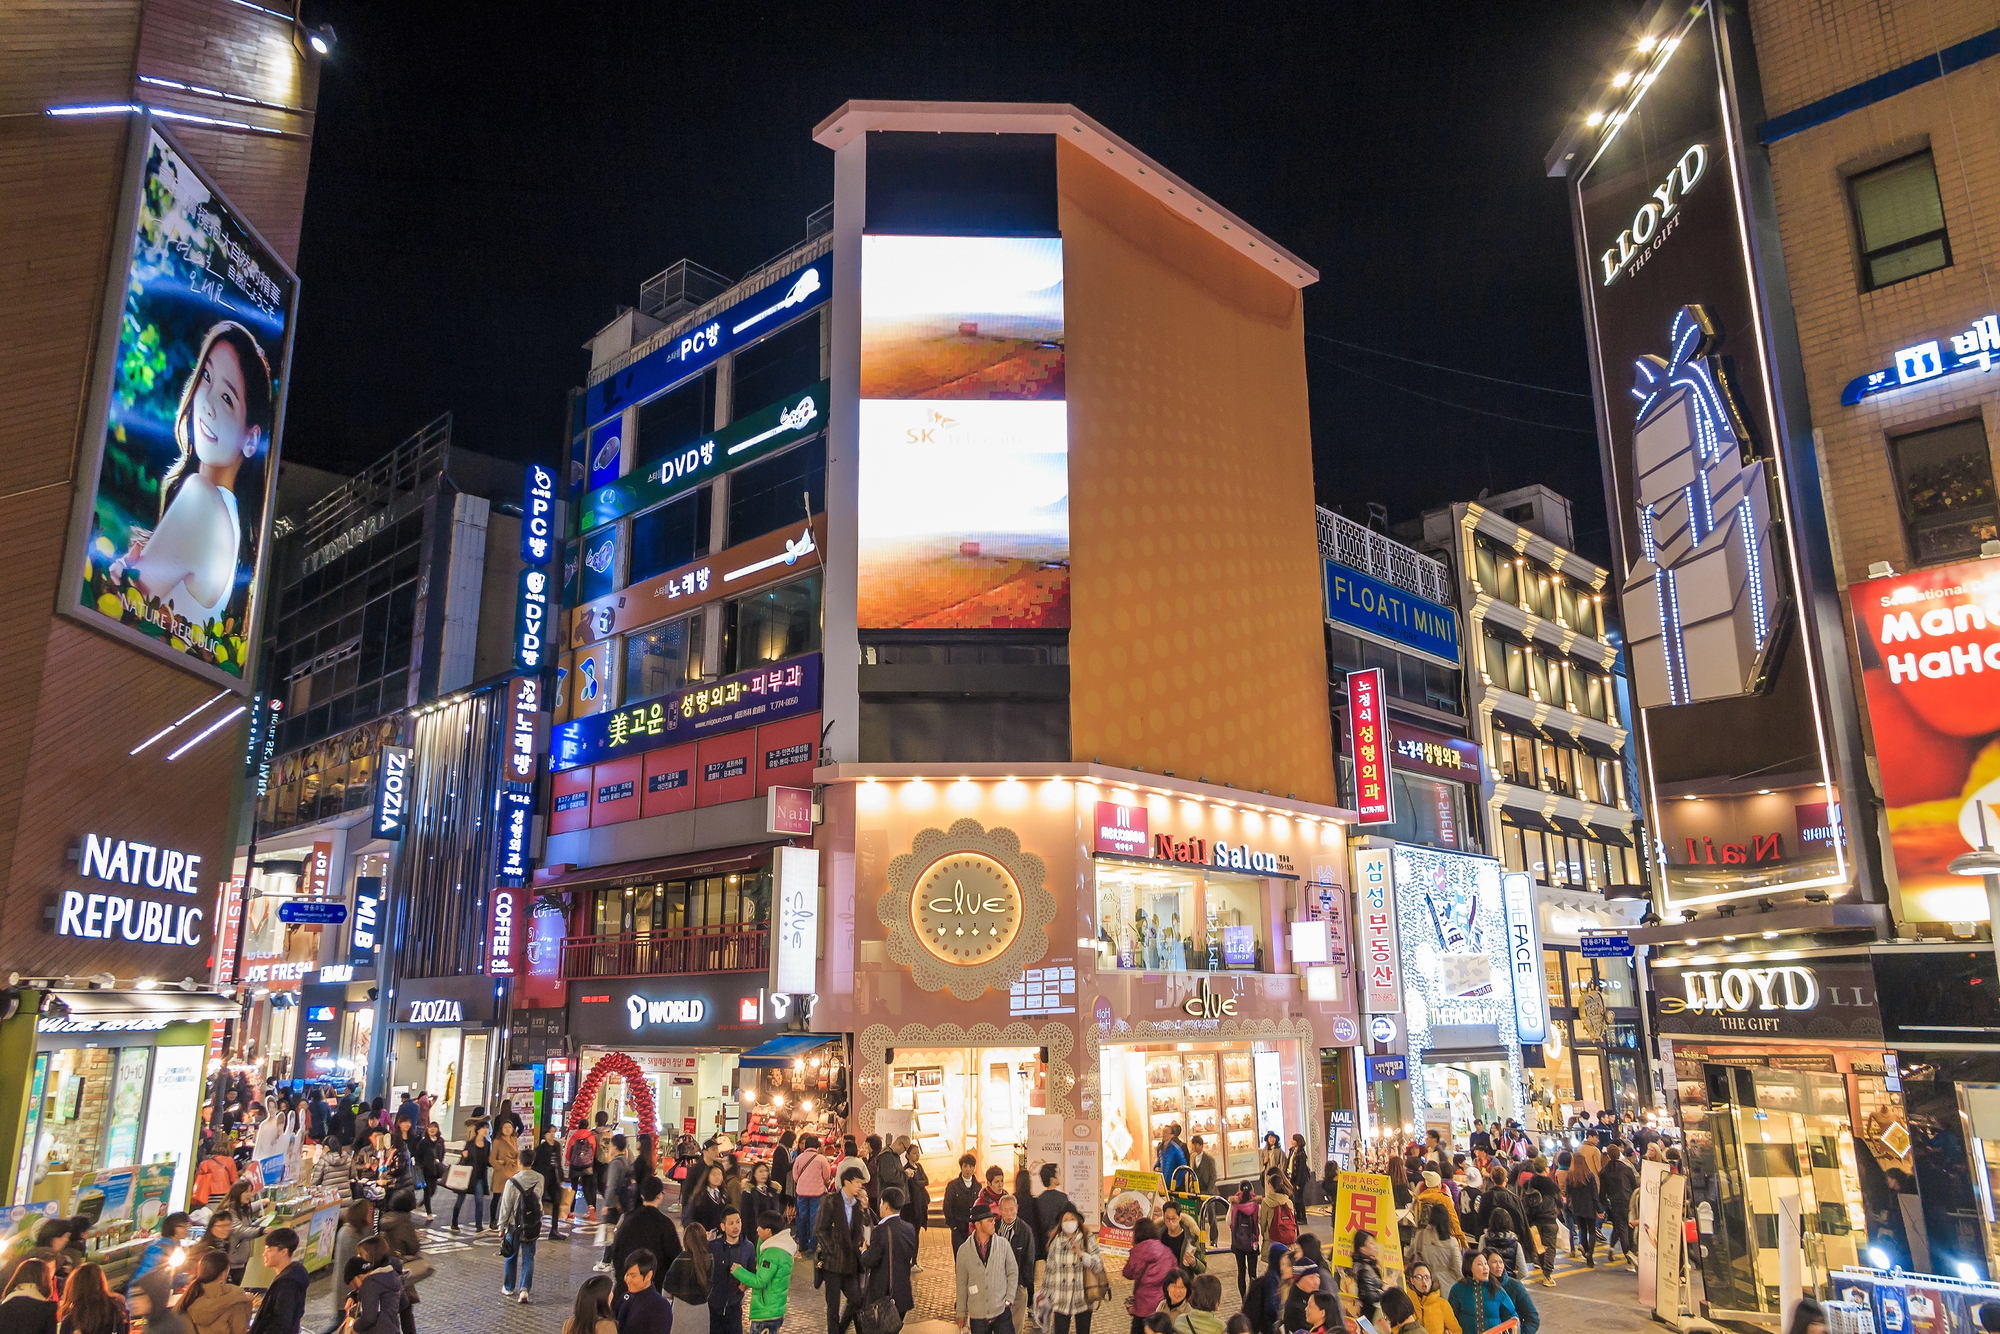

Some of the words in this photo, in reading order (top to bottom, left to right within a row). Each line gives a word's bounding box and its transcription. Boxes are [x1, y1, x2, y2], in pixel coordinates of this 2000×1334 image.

[1601, 144, 1709, 286] LLOYD
[1628, 247, 1651, 278] THE
[1653, 212, 1680, 250] GIFT
[681, 322, 720, 361] PC방
[1868, 371, 1886, 386] 3F
[906, 428, 936, 444] SK
[661, 440, 714, 484] DVD방
[668, 567, 711, 599] 노래방
[119, 590, 167, 630] NATURE
[170, 618, 220, 656] REPUBLIC
[1377, 620, 1395, 635] NEW
[1397, 626, 1418, 643] YORK
[1414, 607, 1452, 643] MINI
[1358, 725, 1380, 801] 성형외과
[381, 752, 406, 832] ZIOZIA
[777, 805, 810, 821] Nail
[82, 833, 202, 894] NATURE
[316, 850, 327, 876] JOE
[1156, 832, 1209, 865] Nail
[1214, 840, 1279, 873] Salon
[928, 879, 1006, 917] clue
[59, 890, 203, 946] REPUBLIC
[354, 895, 378, 949] MLB
[493, 892, 512, 956] COFFEE
[792, 891, 814, 949] clue
[245, 965, 269, 983] JOE
[270, 961, 314, 981] FRESH
[1681, 966, 1819, 1011] LLOYD
[409, 999, 463, 1023] ZIOZIA
[648, 999, 705, 1024] WORLD
[1185, 977, 1238, 1017] clue
[1720, 1016, 1746, 1031] THE
[1748, 1017, 1780, 1032] GIFT
[546, 1048, 562, 1056] COFFEE
[1331, 1111, 1353, 1123] NAIL
[1067, 1149, 1096, 1157] TOURIST
[1342, 1181, 1357, 1191] Foot
[1360, 1184, 1387, 1195] Massage
[1359, 1176, 1380, 1186] ABC
[1645, 1180, 1660, 1196] Gif
[1344, 1192, 1379, 1238] 足
[1664, 1197, 1682, 1210] TOURIST
